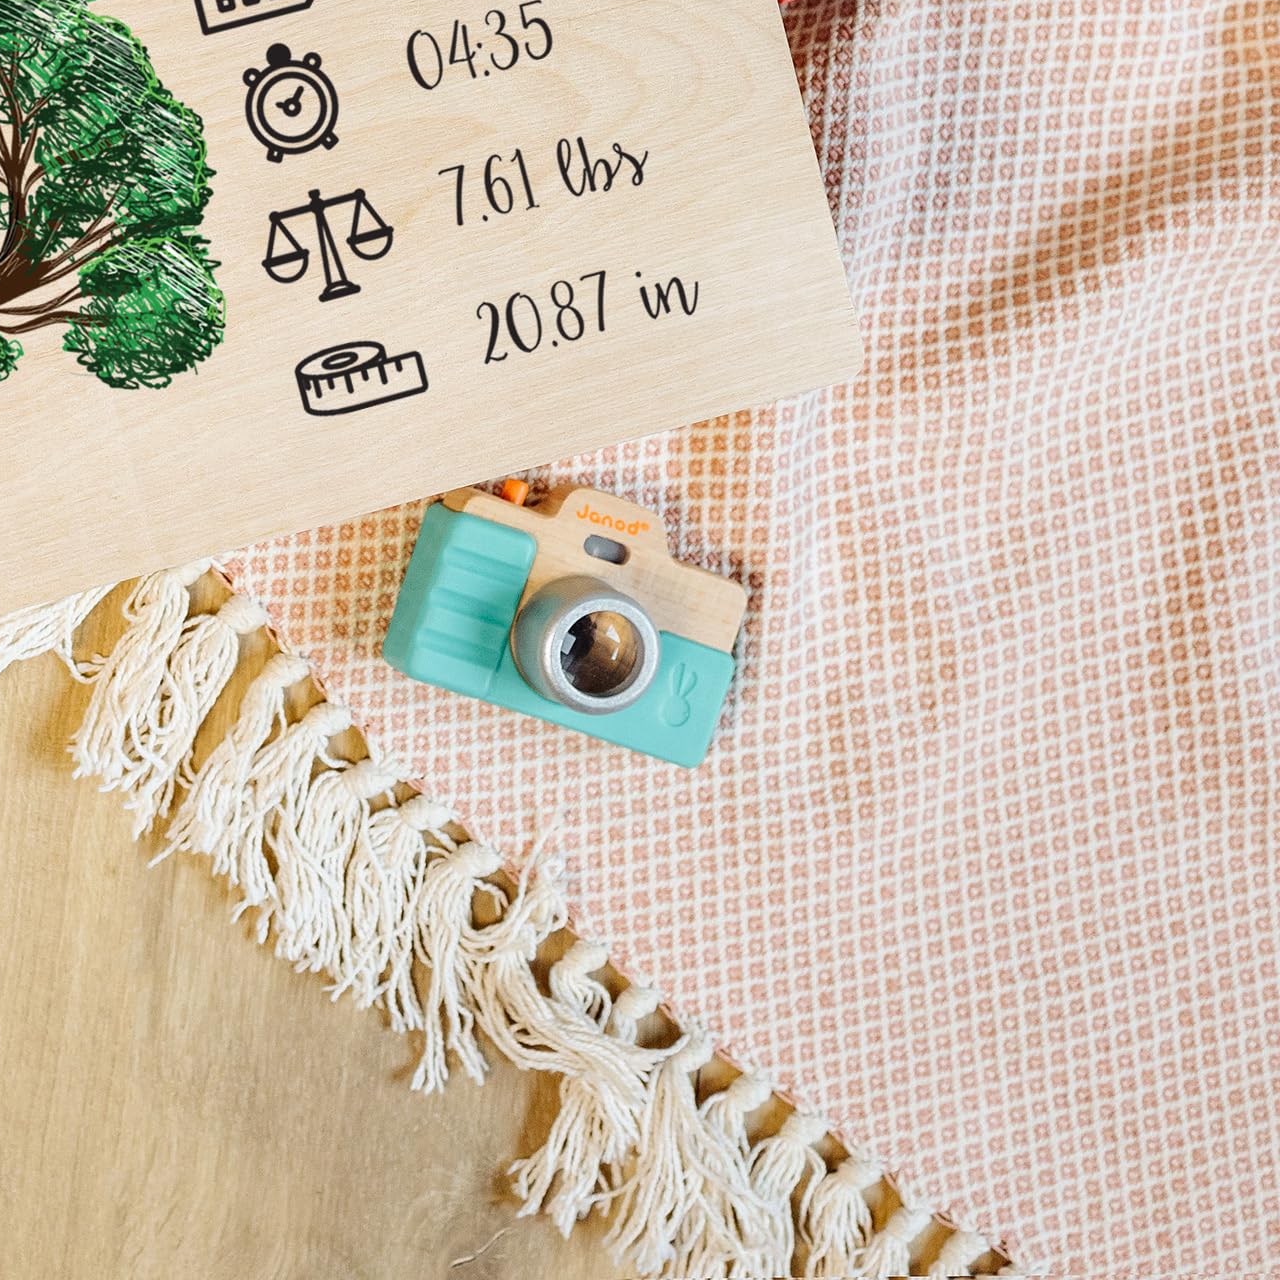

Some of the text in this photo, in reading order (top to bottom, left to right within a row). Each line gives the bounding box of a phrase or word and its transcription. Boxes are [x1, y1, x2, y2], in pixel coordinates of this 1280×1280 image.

[405, 0, 554, 91] 04:35
[437, 136, 650, 227] 7.61 lbs
[475, 270, 699, 366] 20.87 in
